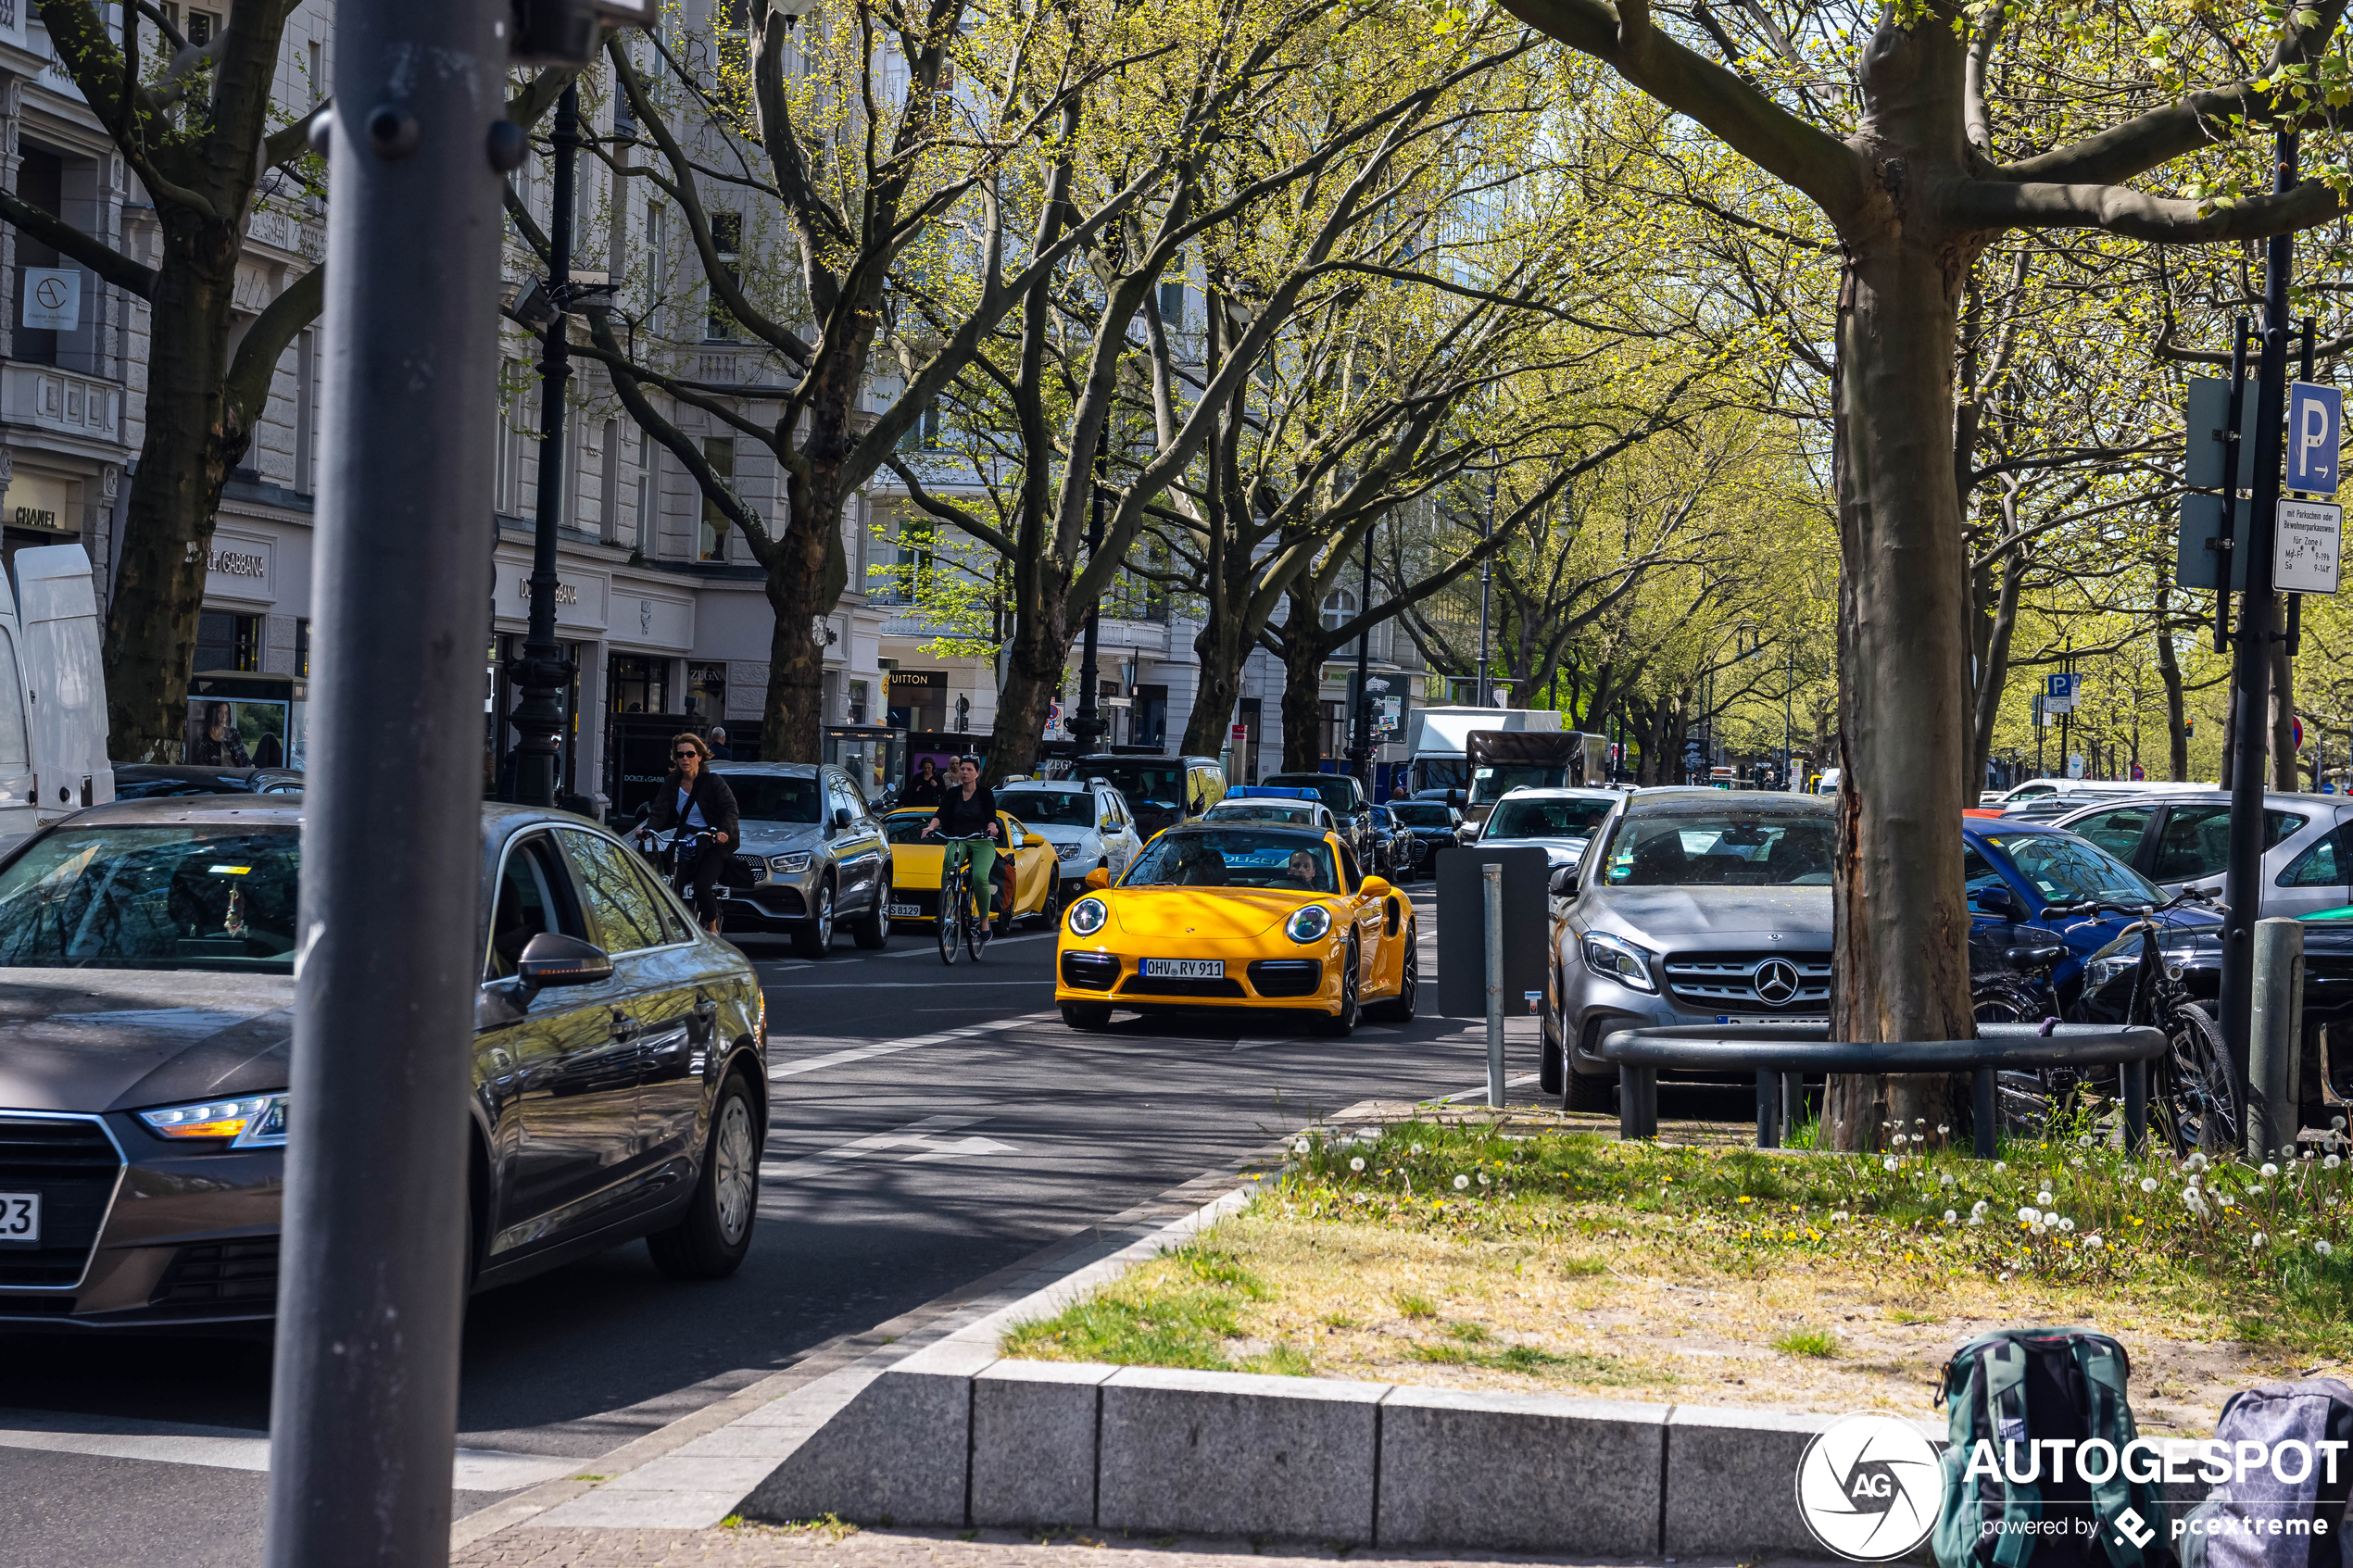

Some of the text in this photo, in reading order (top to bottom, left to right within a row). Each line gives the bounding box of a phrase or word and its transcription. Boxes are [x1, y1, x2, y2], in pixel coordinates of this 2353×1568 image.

[2299, 398, 2329, 476] P
[16, 506, 57, 528] CHANEL
[2296, 509, 2321, 520] Parkschein
[2323, 513, 2334, 521] oder
[2284, 521, 2334, 533] Bewohnerparkausweis
[2293, 536, 2302, 545] für
[2305, 537, 2318, 546] Zone
[222, 551, 264, 577] GABBANA
[2285, 561, 2293, 570] Sa
[556, 583, 577, 604] BBANA
[2053, 677, 2067, 694] P
[624, 774, 644, 783] DOLCE
[1224, 856, 1276, 865] OLIZEI
[898, 906, 919, 915] 8129
[1148, 960, 1221, 976] OHV RY 911
